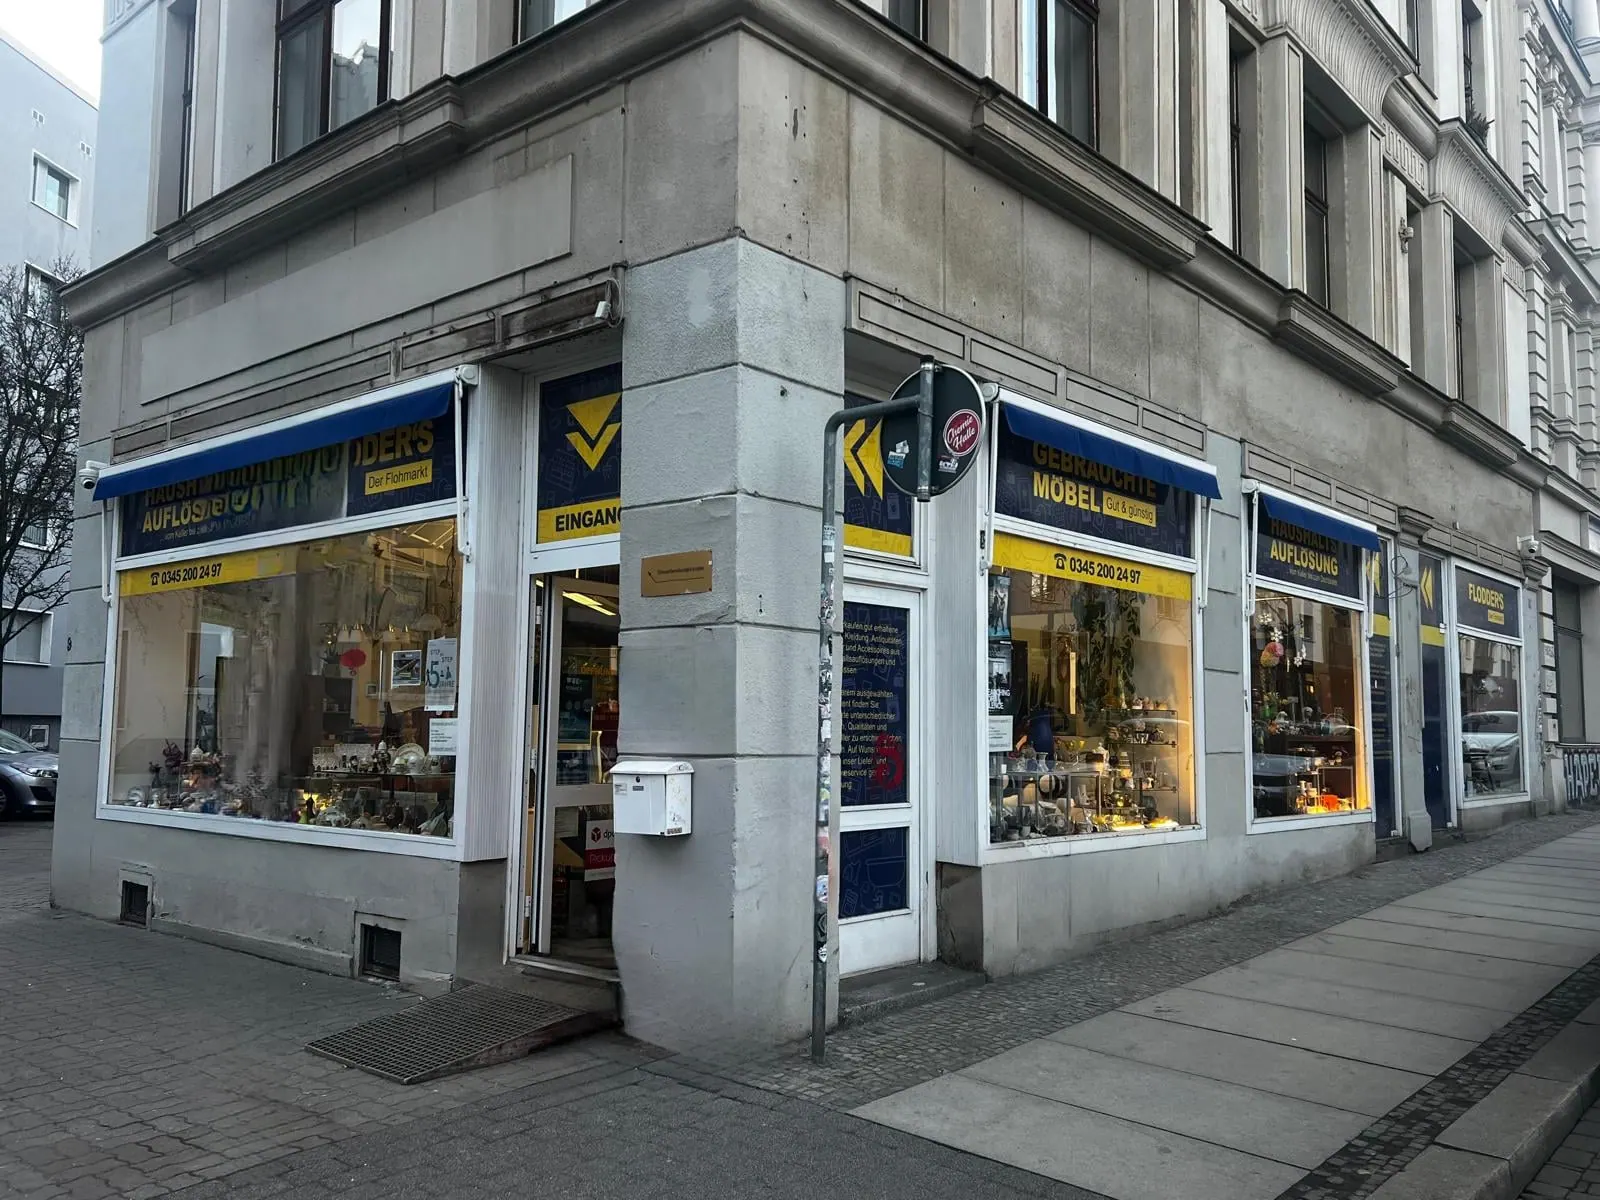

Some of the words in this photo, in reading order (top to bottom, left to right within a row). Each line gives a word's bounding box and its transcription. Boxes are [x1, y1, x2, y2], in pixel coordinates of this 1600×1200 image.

[368, 474, 384, 488] Der
[386, 466, 428, 486] Flohmarkt
[1033, 471, 1101, 513] MÖBEL
[1106, 497, 1119, 512] Gut
[1121, 501, 1127, 513] &
[1128, 504, 1154, 523] günstig
[1069, 557, 1094, 576] 0345
[1097, 562, 1115, 580] 200
[1116, 566, 1129, 582] 24
[1130, 568, 1141, 584] 97
[1270, 539, 1339, 576] AUFLÖSUNG
[161, 569, 181, 584] 0345
[182, 567, 198, 581] 200
[199, 564, 210, 579] 24
[211, 563, 222, 577] 97
